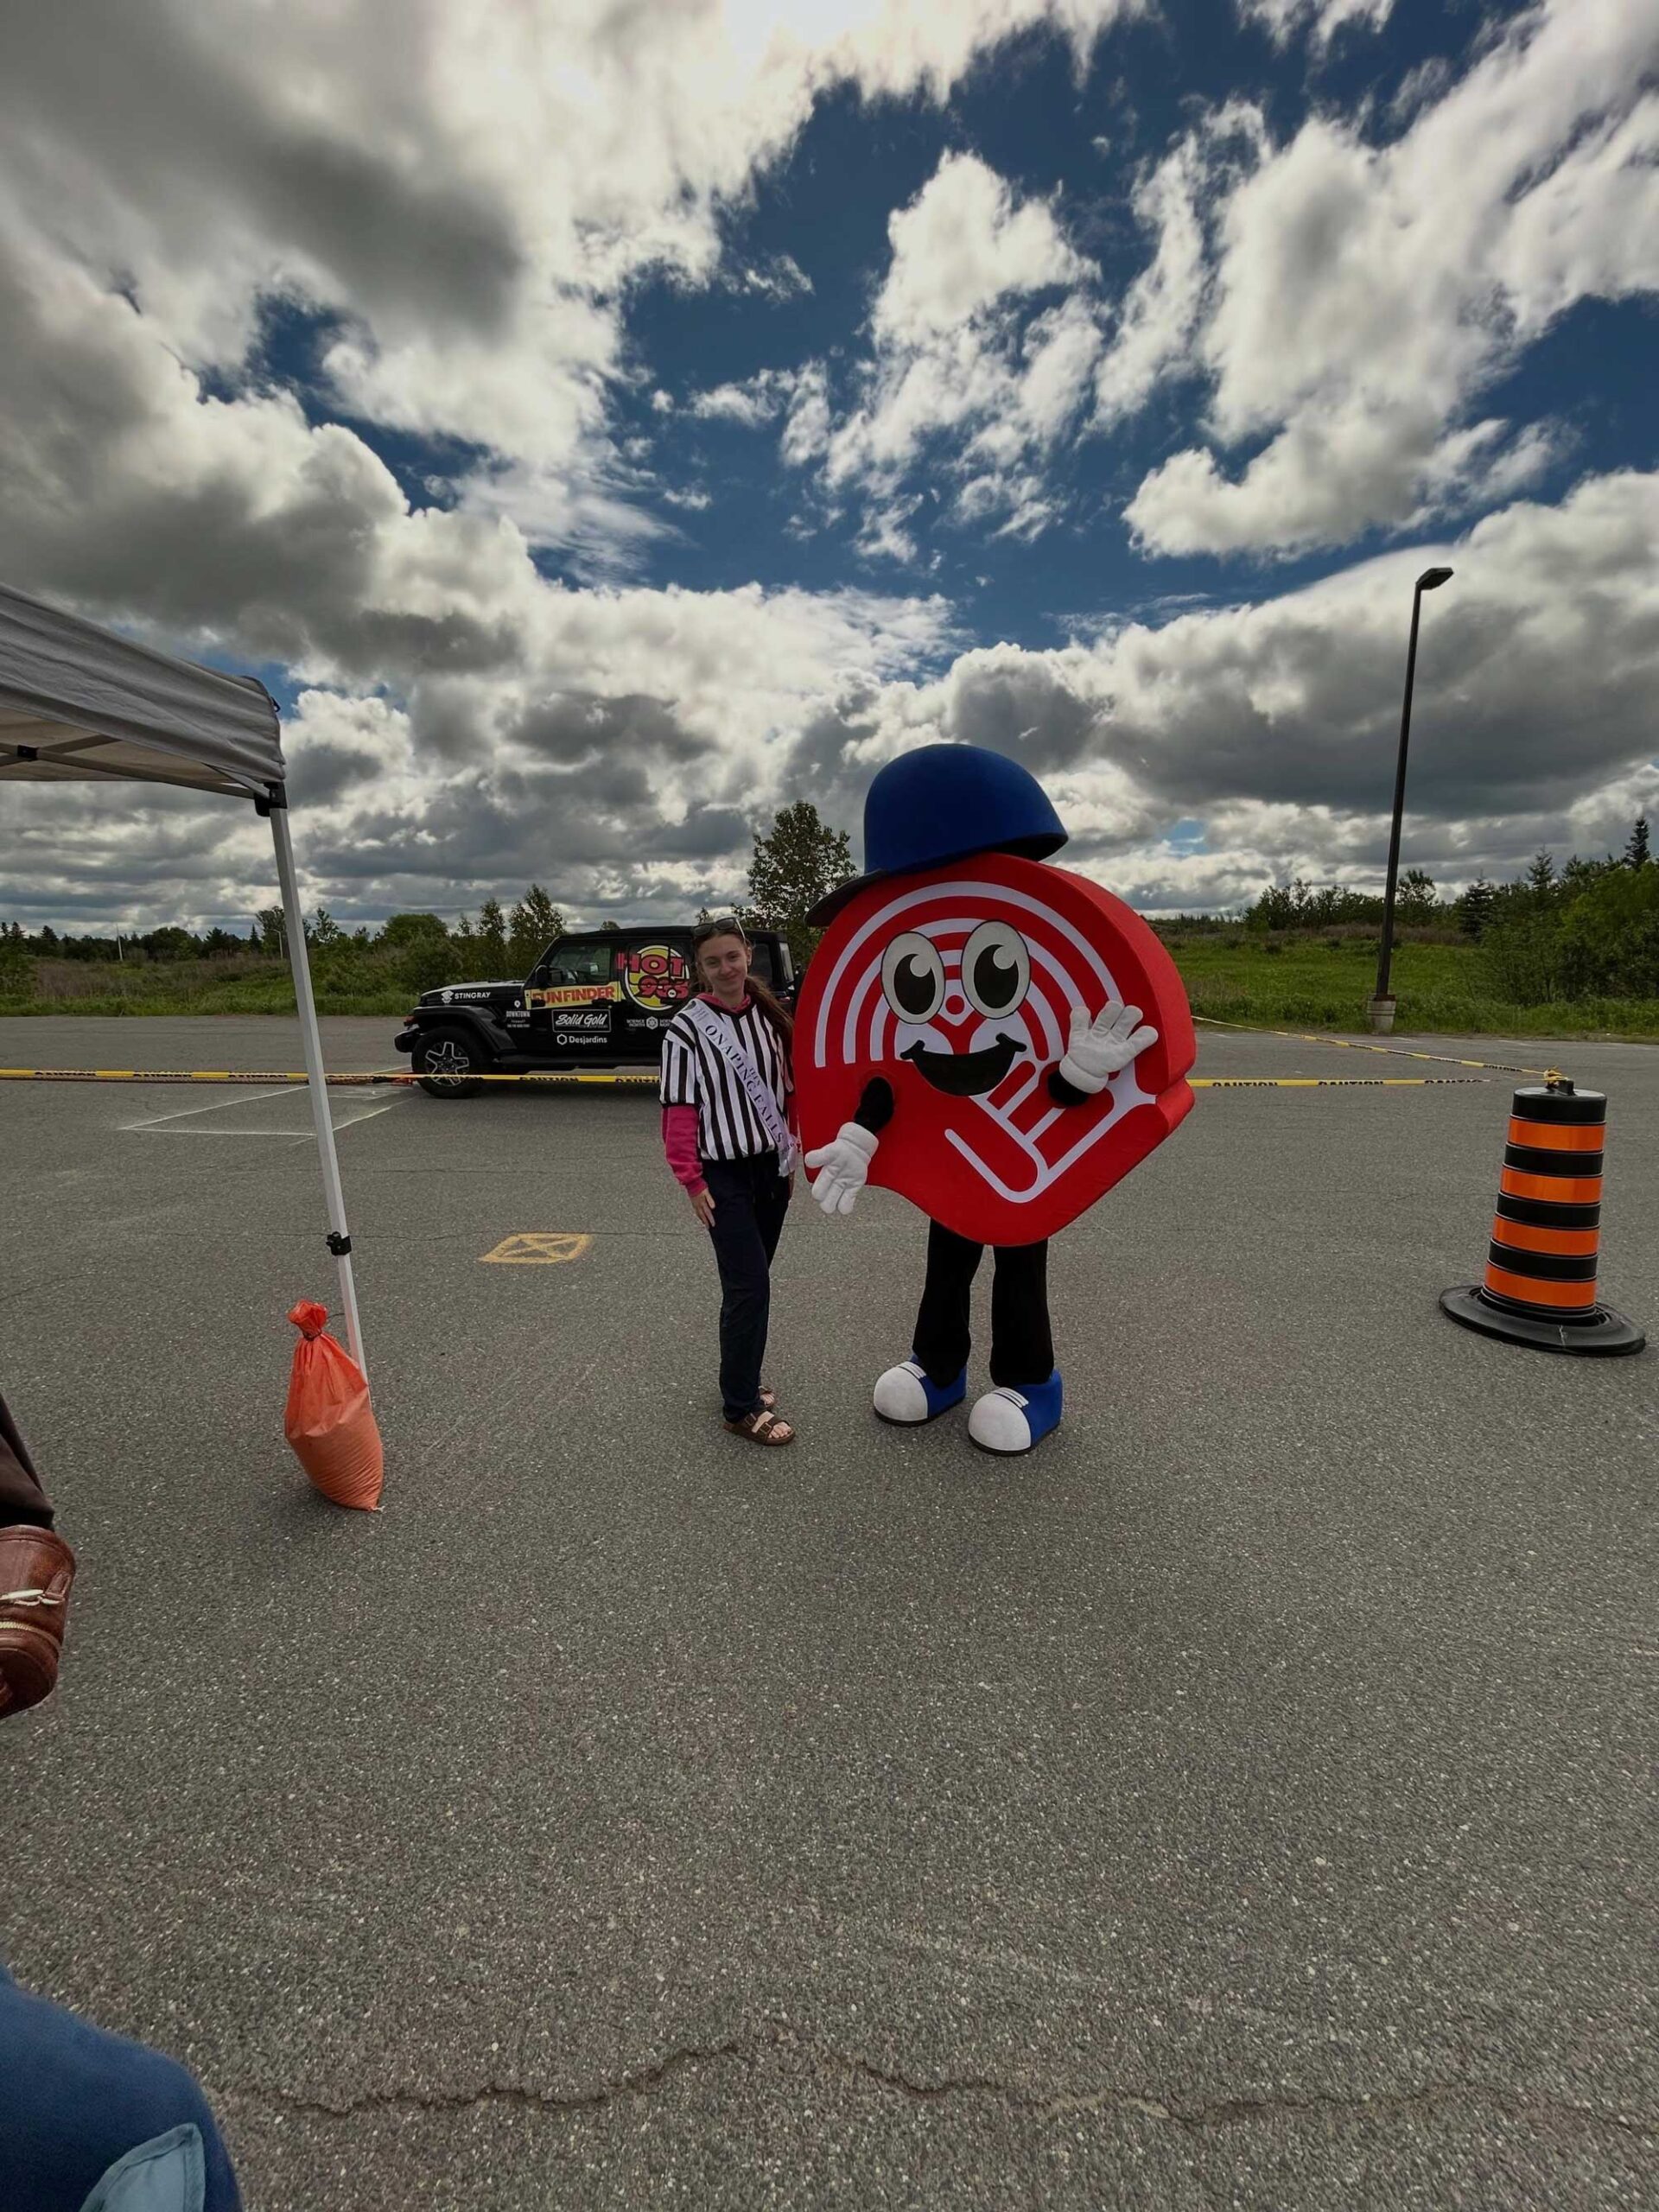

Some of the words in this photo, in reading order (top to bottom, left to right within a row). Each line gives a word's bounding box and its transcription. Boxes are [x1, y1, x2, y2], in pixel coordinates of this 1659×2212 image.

[615, 952, 684, 977] HOT
[555, 1014, 584, 1026] Solid
[583, 1014, 607, 1028] Gold
[569, 1036, 607, 1045] Desjardins
[705, 1025, 757, 1092] ONAPING
[753, 1094, 785, 1143] FALLS
